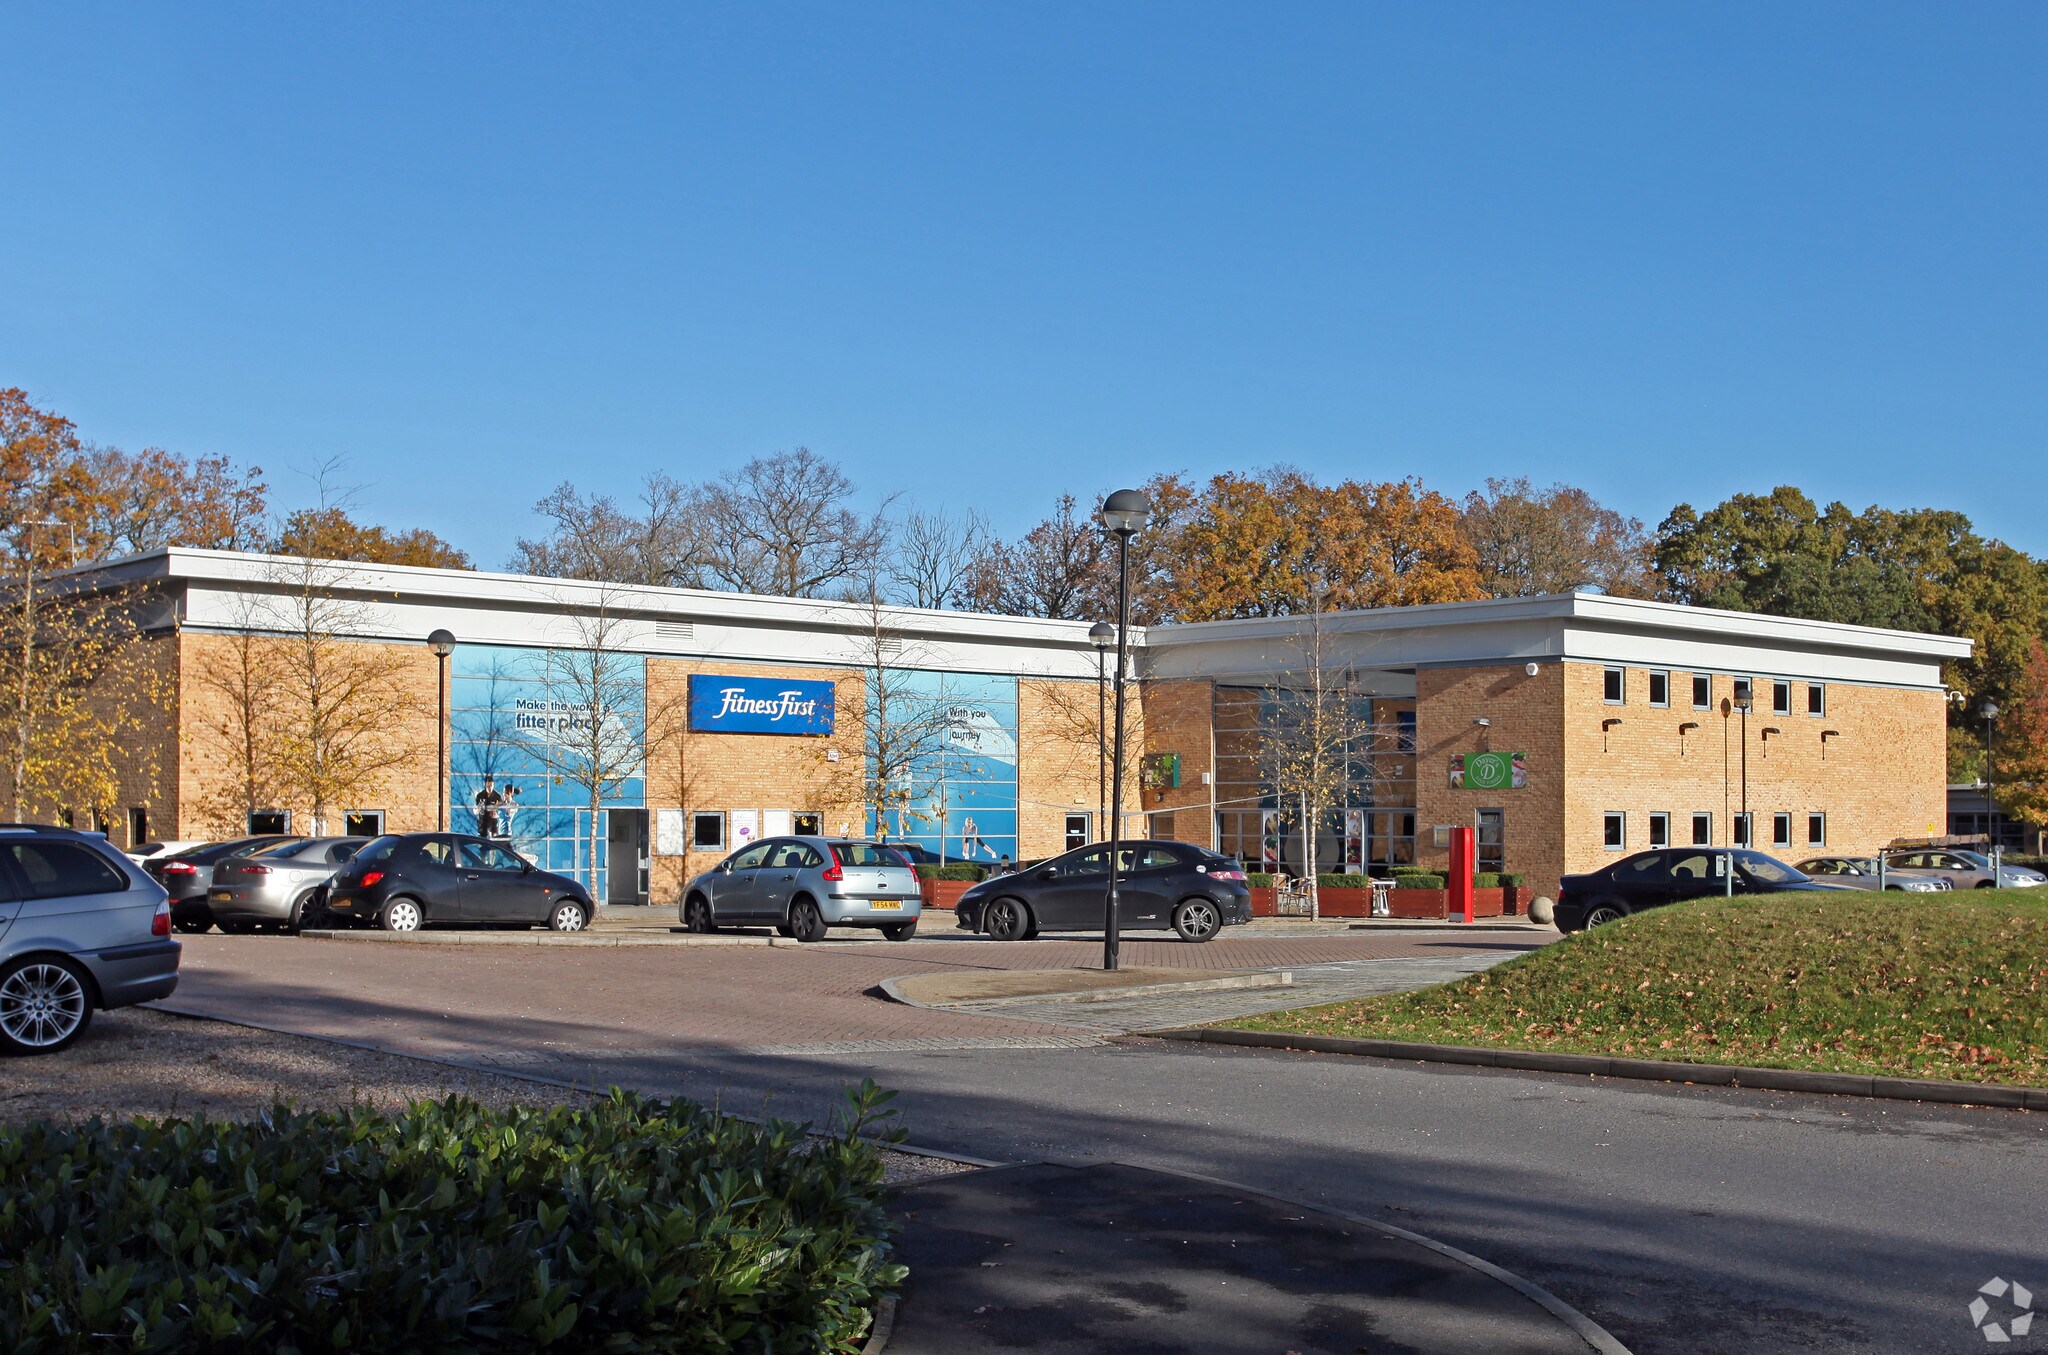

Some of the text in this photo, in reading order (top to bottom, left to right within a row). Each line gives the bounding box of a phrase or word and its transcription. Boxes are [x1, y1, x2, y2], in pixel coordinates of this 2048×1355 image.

[516, 699, 546, 710] Make
[949, 706, 986, 720] With you
[516, 713, 555, 729] fitter
[948, 728, 981, 742] journey
[1480, 763, 1495, 780] D
